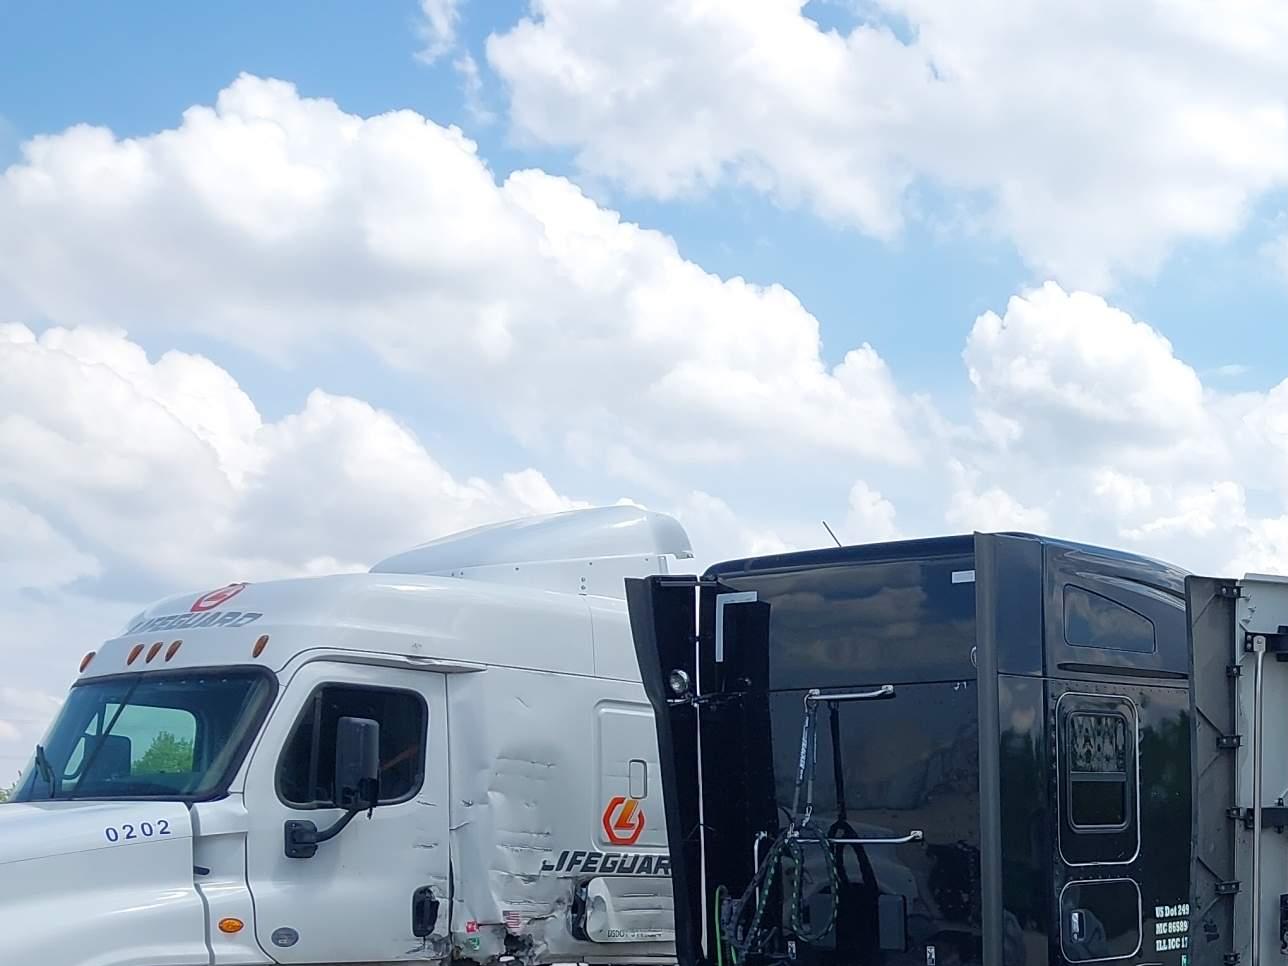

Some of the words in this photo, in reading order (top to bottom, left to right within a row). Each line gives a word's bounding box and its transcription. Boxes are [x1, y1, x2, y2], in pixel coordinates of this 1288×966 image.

[123, 612, 263, 636] LIFEGUARD
[105, 819, 171, 842] 0202
[541, 850, 672, 875] LIFEGUAR
[1156, 907, 1164, 917] US
[1164, 906, 1177, 916] Dot
[1156, 924, 1168, 935] MC
